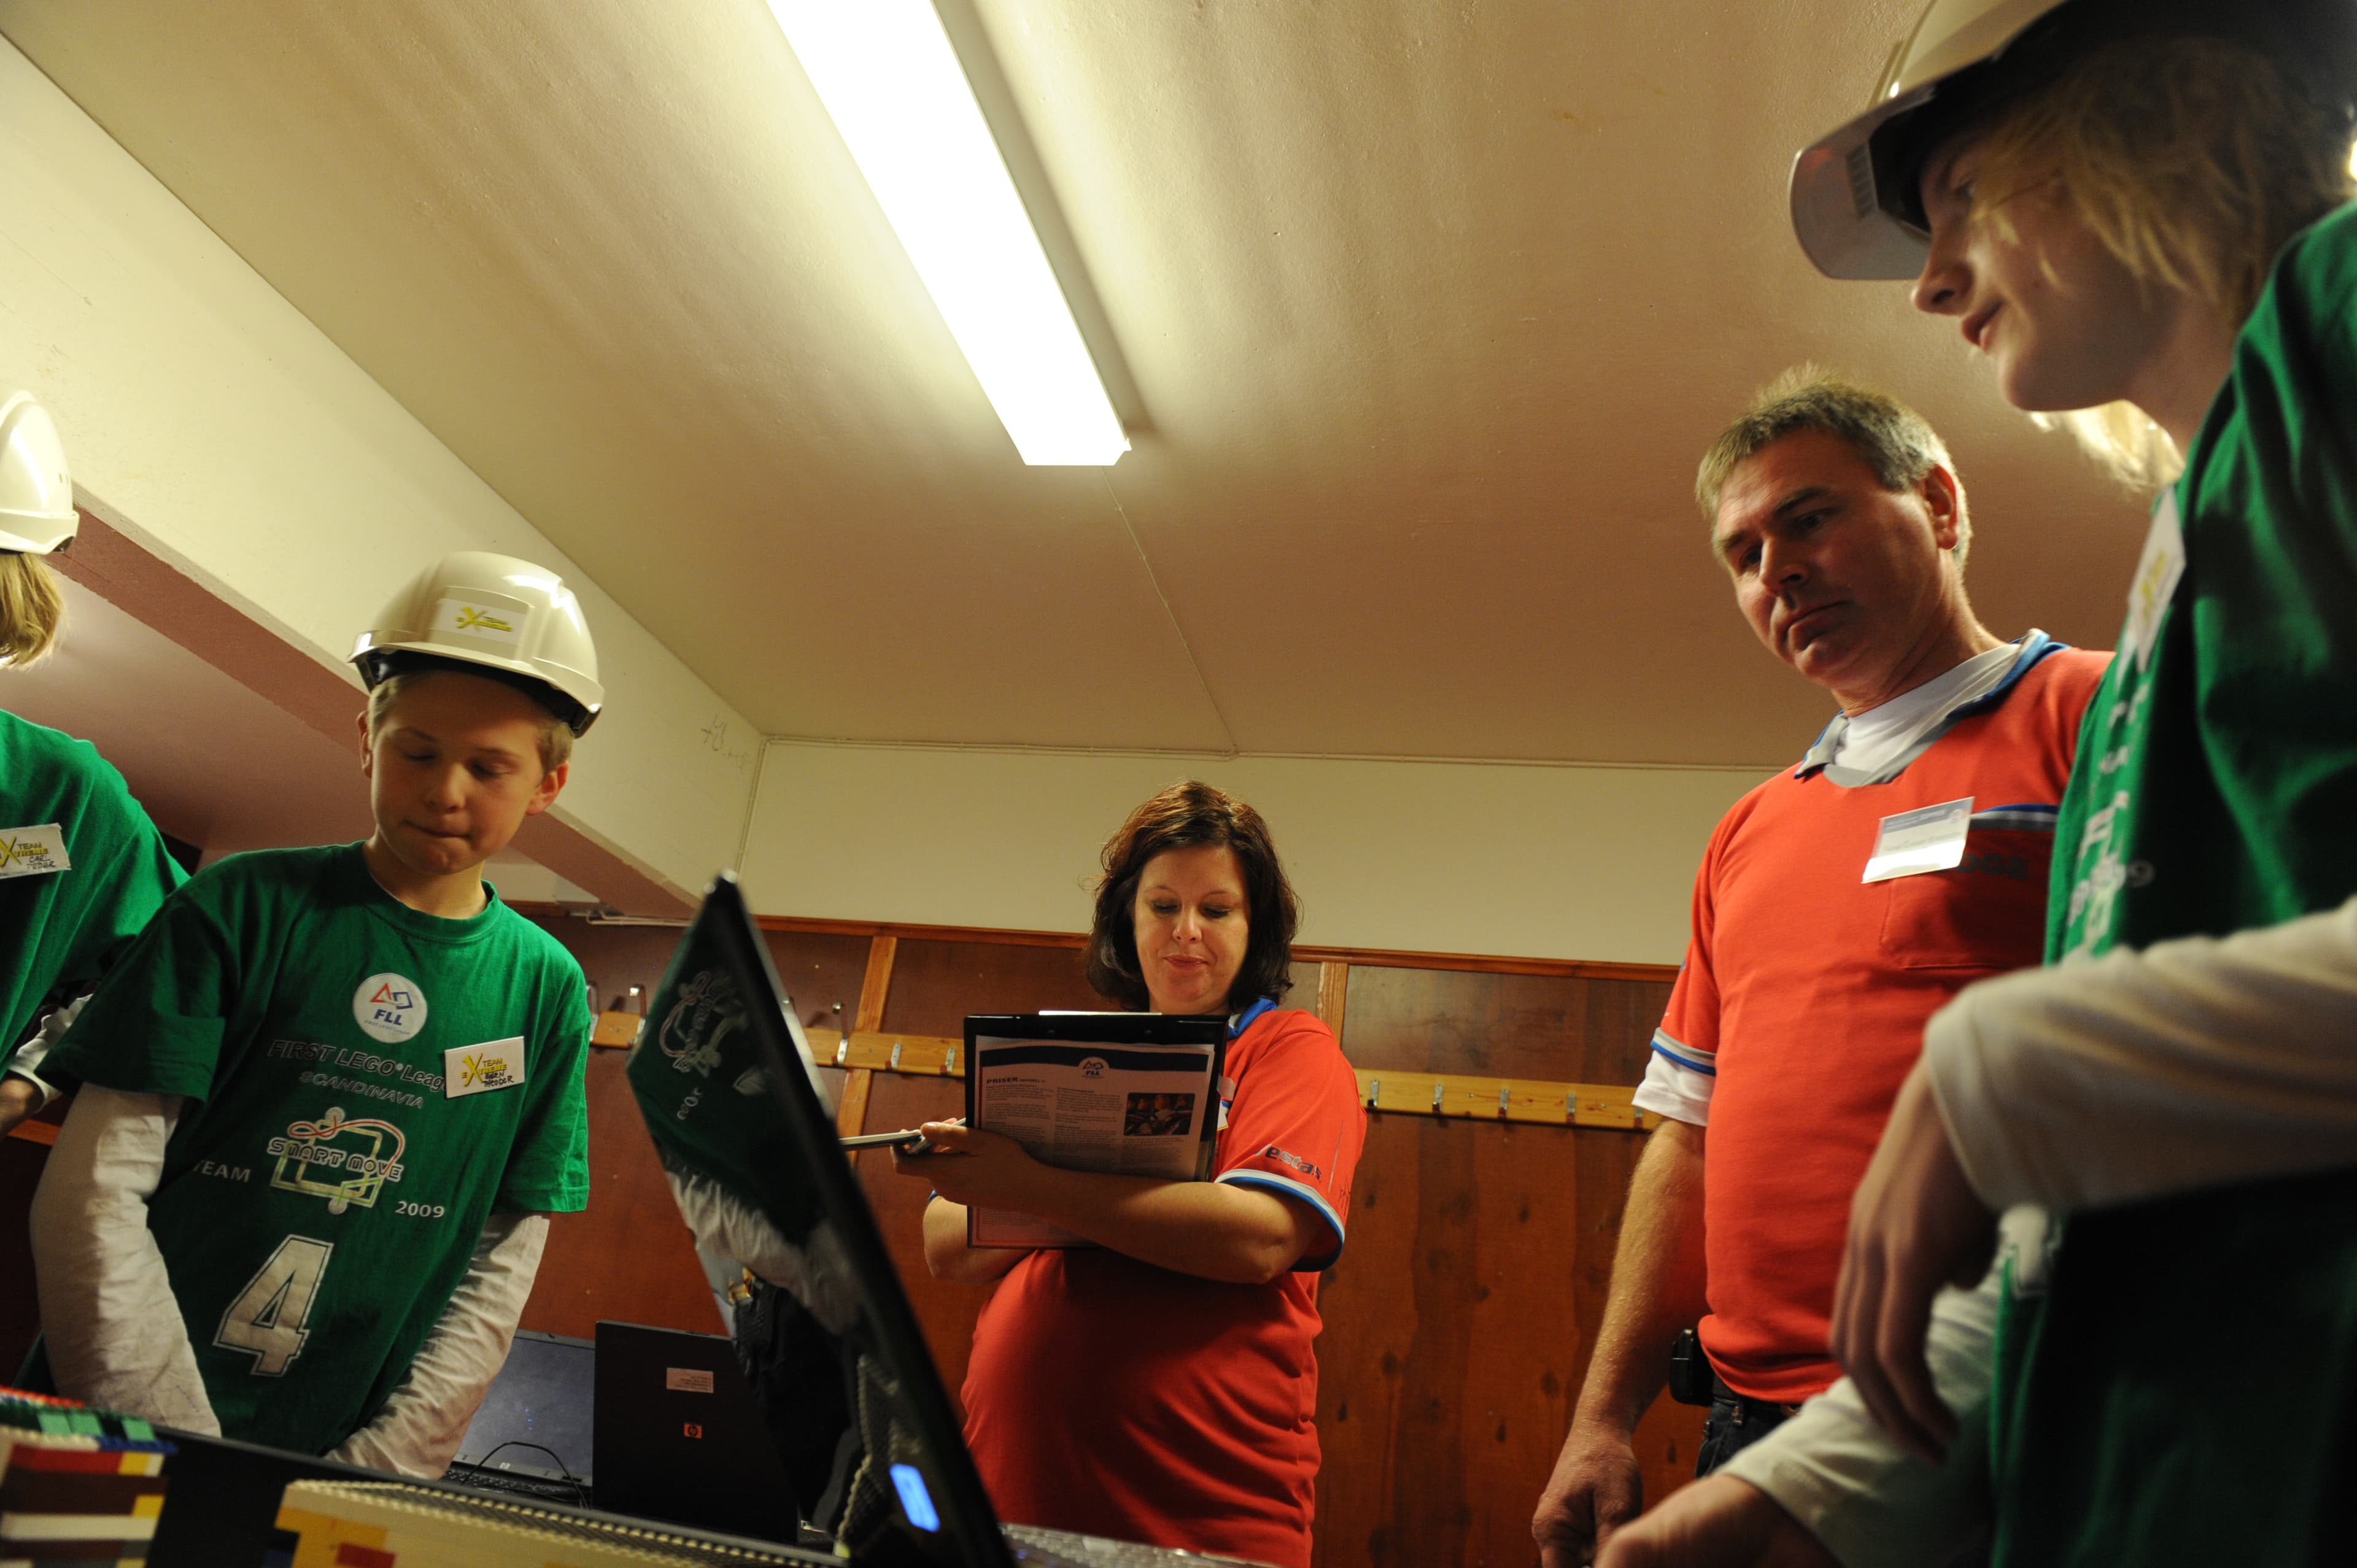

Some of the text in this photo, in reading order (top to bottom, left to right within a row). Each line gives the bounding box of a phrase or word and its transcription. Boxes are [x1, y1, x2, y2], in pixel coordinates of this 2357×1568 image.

[374, 1008, 402, 1025] FLL
[268, 1040, 336, 1062] FIRST
[400, 1065, 446, 1092] Leag
[482, 1058, 503, 1068] TEAM
[299, 1071, 424, 1108] SCANDINAVIA
[268, 1138, 403, 1181] SMART MOVE
[396, 1201, 446, 1218] 2009
[213, 1234, 334, 1378] 4
